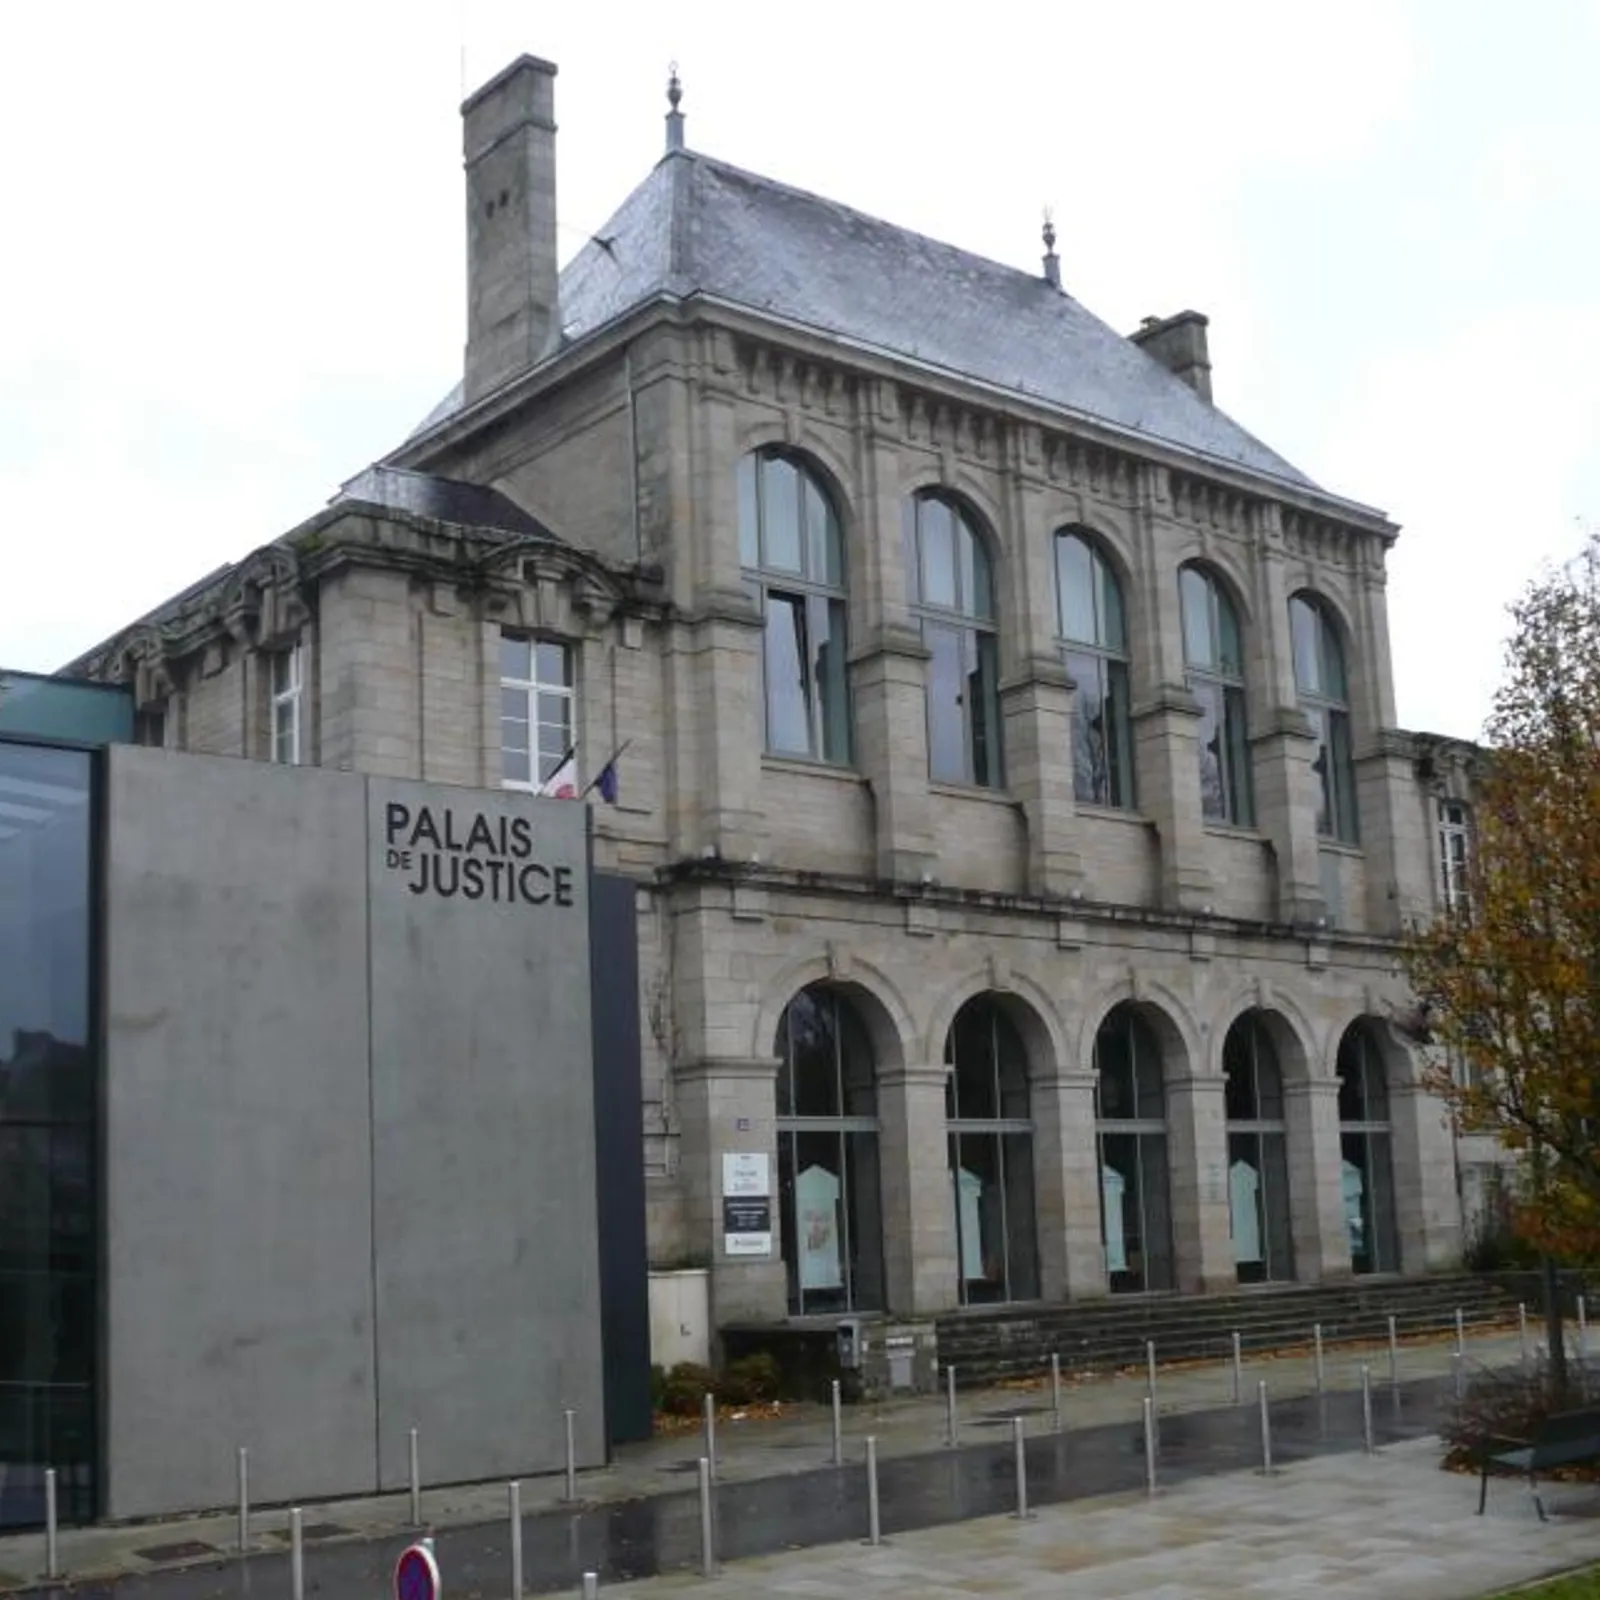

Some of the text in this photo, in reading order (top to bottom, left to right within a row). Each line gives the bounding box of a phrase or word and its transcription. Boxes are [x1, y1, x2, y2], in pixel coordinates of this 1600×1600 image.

[386, 802, 533, 858] PALAIS
[386, 849, 574, 907] DE JUSTICE
